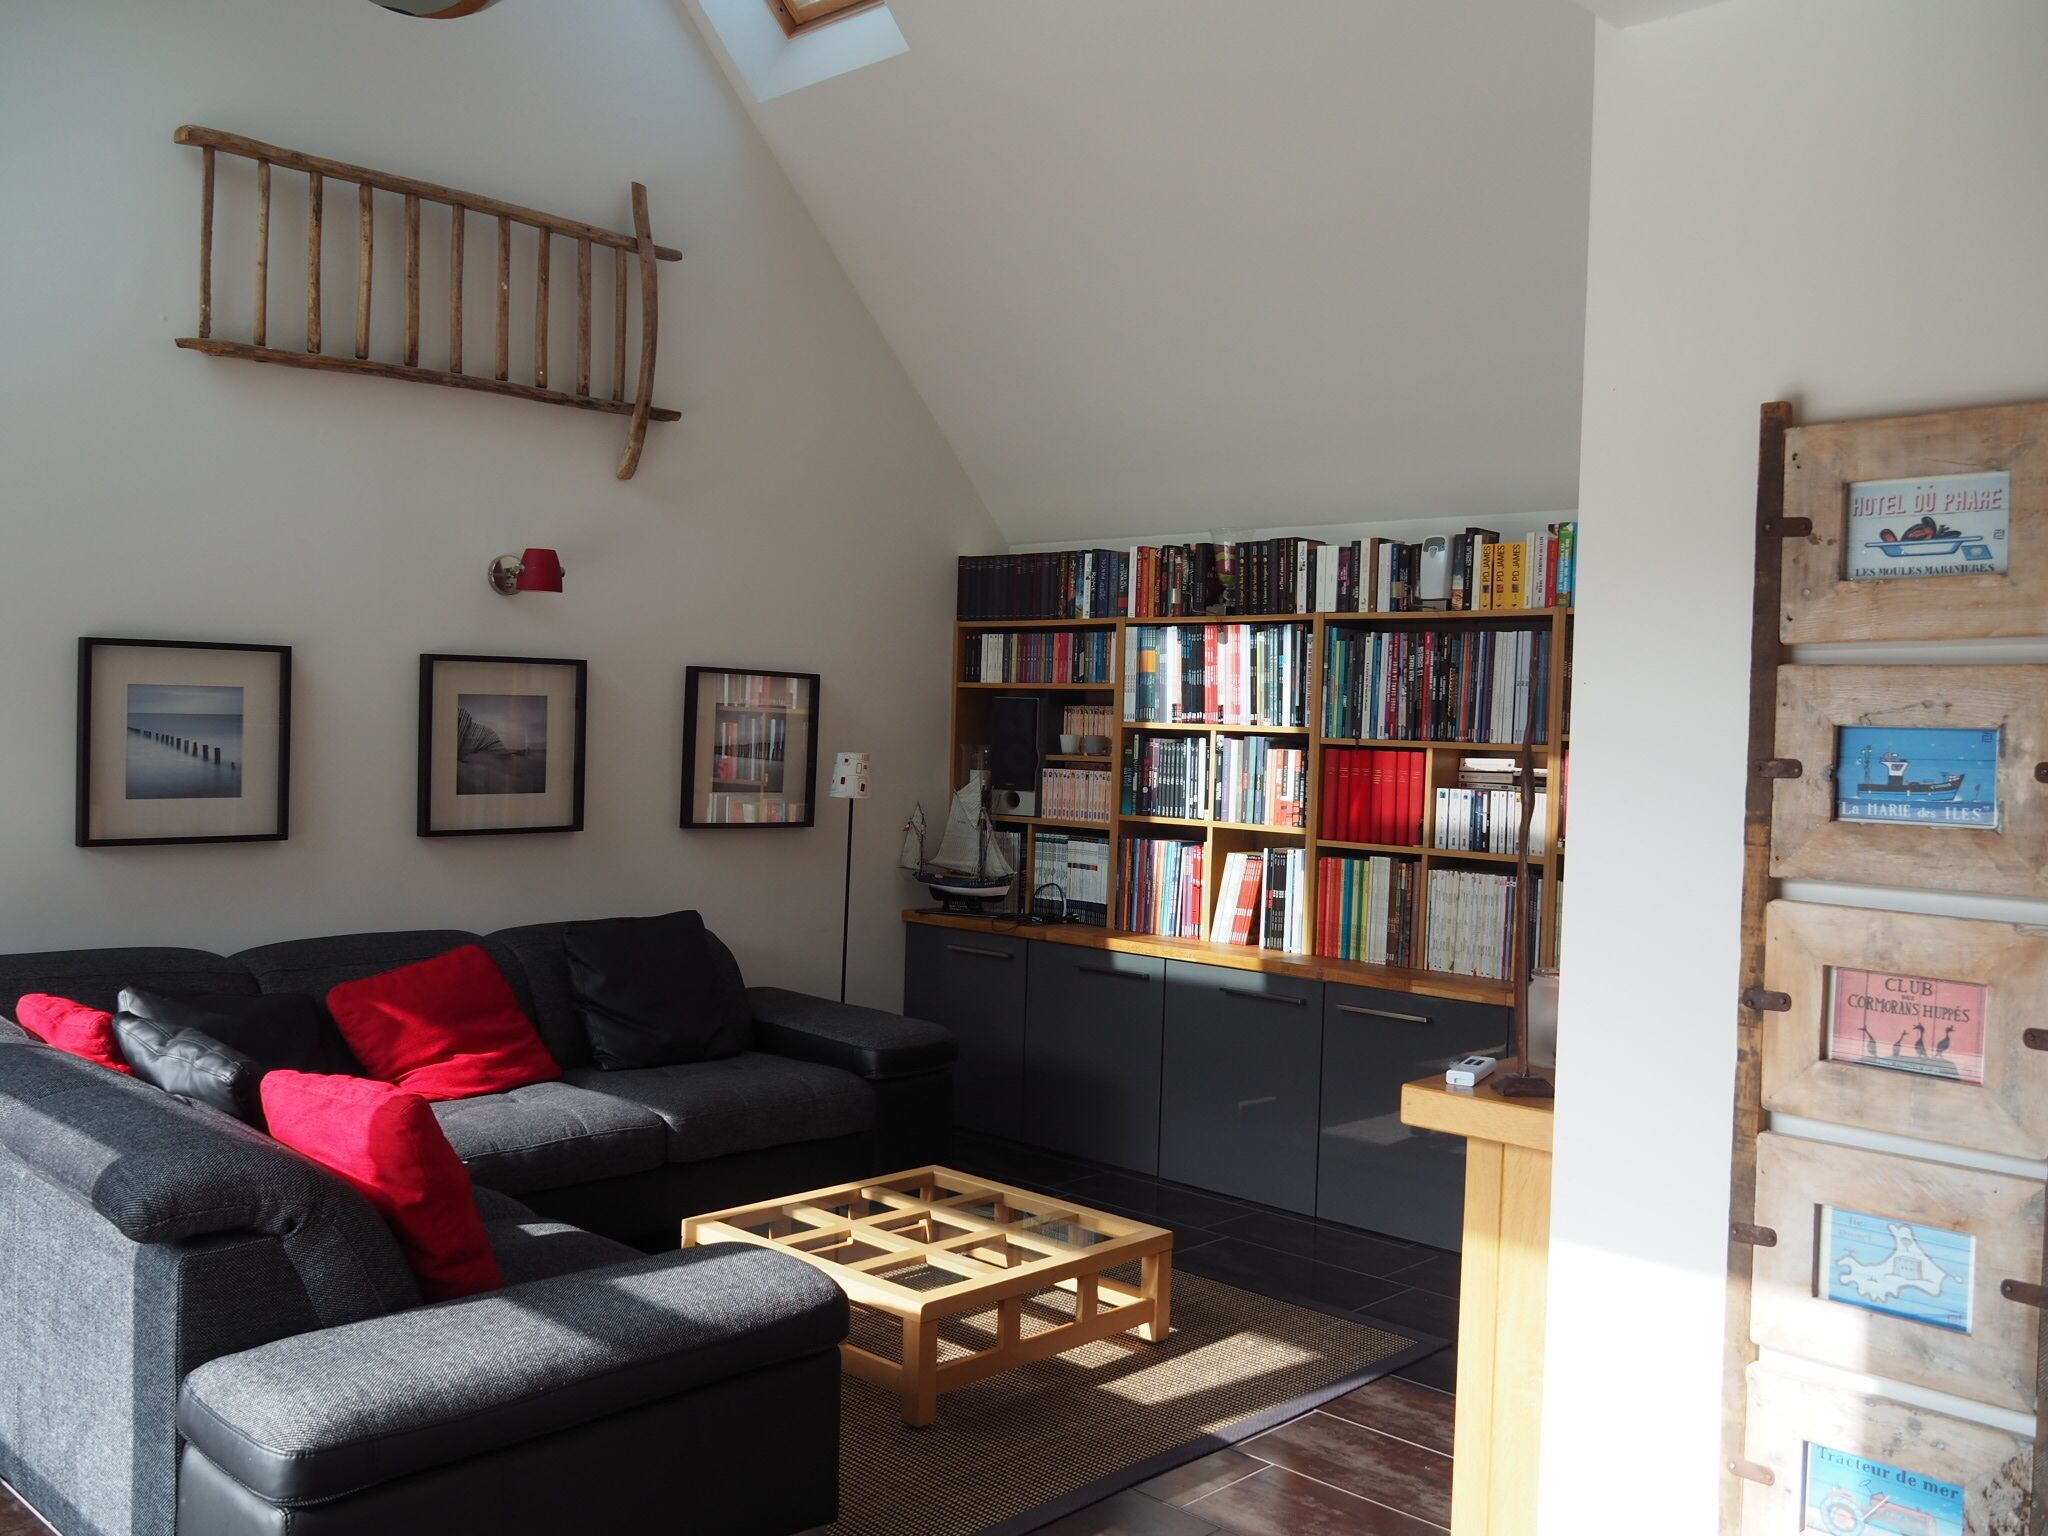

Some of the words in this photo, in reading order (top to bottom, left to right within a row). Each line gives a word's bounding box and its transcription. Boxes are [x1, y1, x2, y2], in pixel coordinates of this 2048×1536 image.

[1852, 495, 1906, 516] HOTEL
[1914, 492, 1937, 513] DU
[1944, 489, 2003, 511] PHARE
[1483, 545, 1491, 569] JAMES
[1496, 545, 1504, 569] JAMES
[1512, 544, 1521, 569] JAMES
[1855, 567, 1876, 577] LES
[1878, 565, 1922, 576] MOULES
[1925, 563, 1996, 575] MARINIERES
[1841, 801, 1859, 815] La
[1867, 802, 1911, 817] MARIE
[1917, 806, 1936, 818] des
[1945, 806, 1982, 821] ILES
[1885, 978, 1933, 996] CLUB
[1847, 994, 1919, 1016] CORMORANS
[1922, 1005, 1970, 1022] HUPPÉS
[1818, 1446, 1889, 1479] Tracteur
[1896, 1470, 1917, 1487] de
[1922, 1482, 1960, 1499] mer
